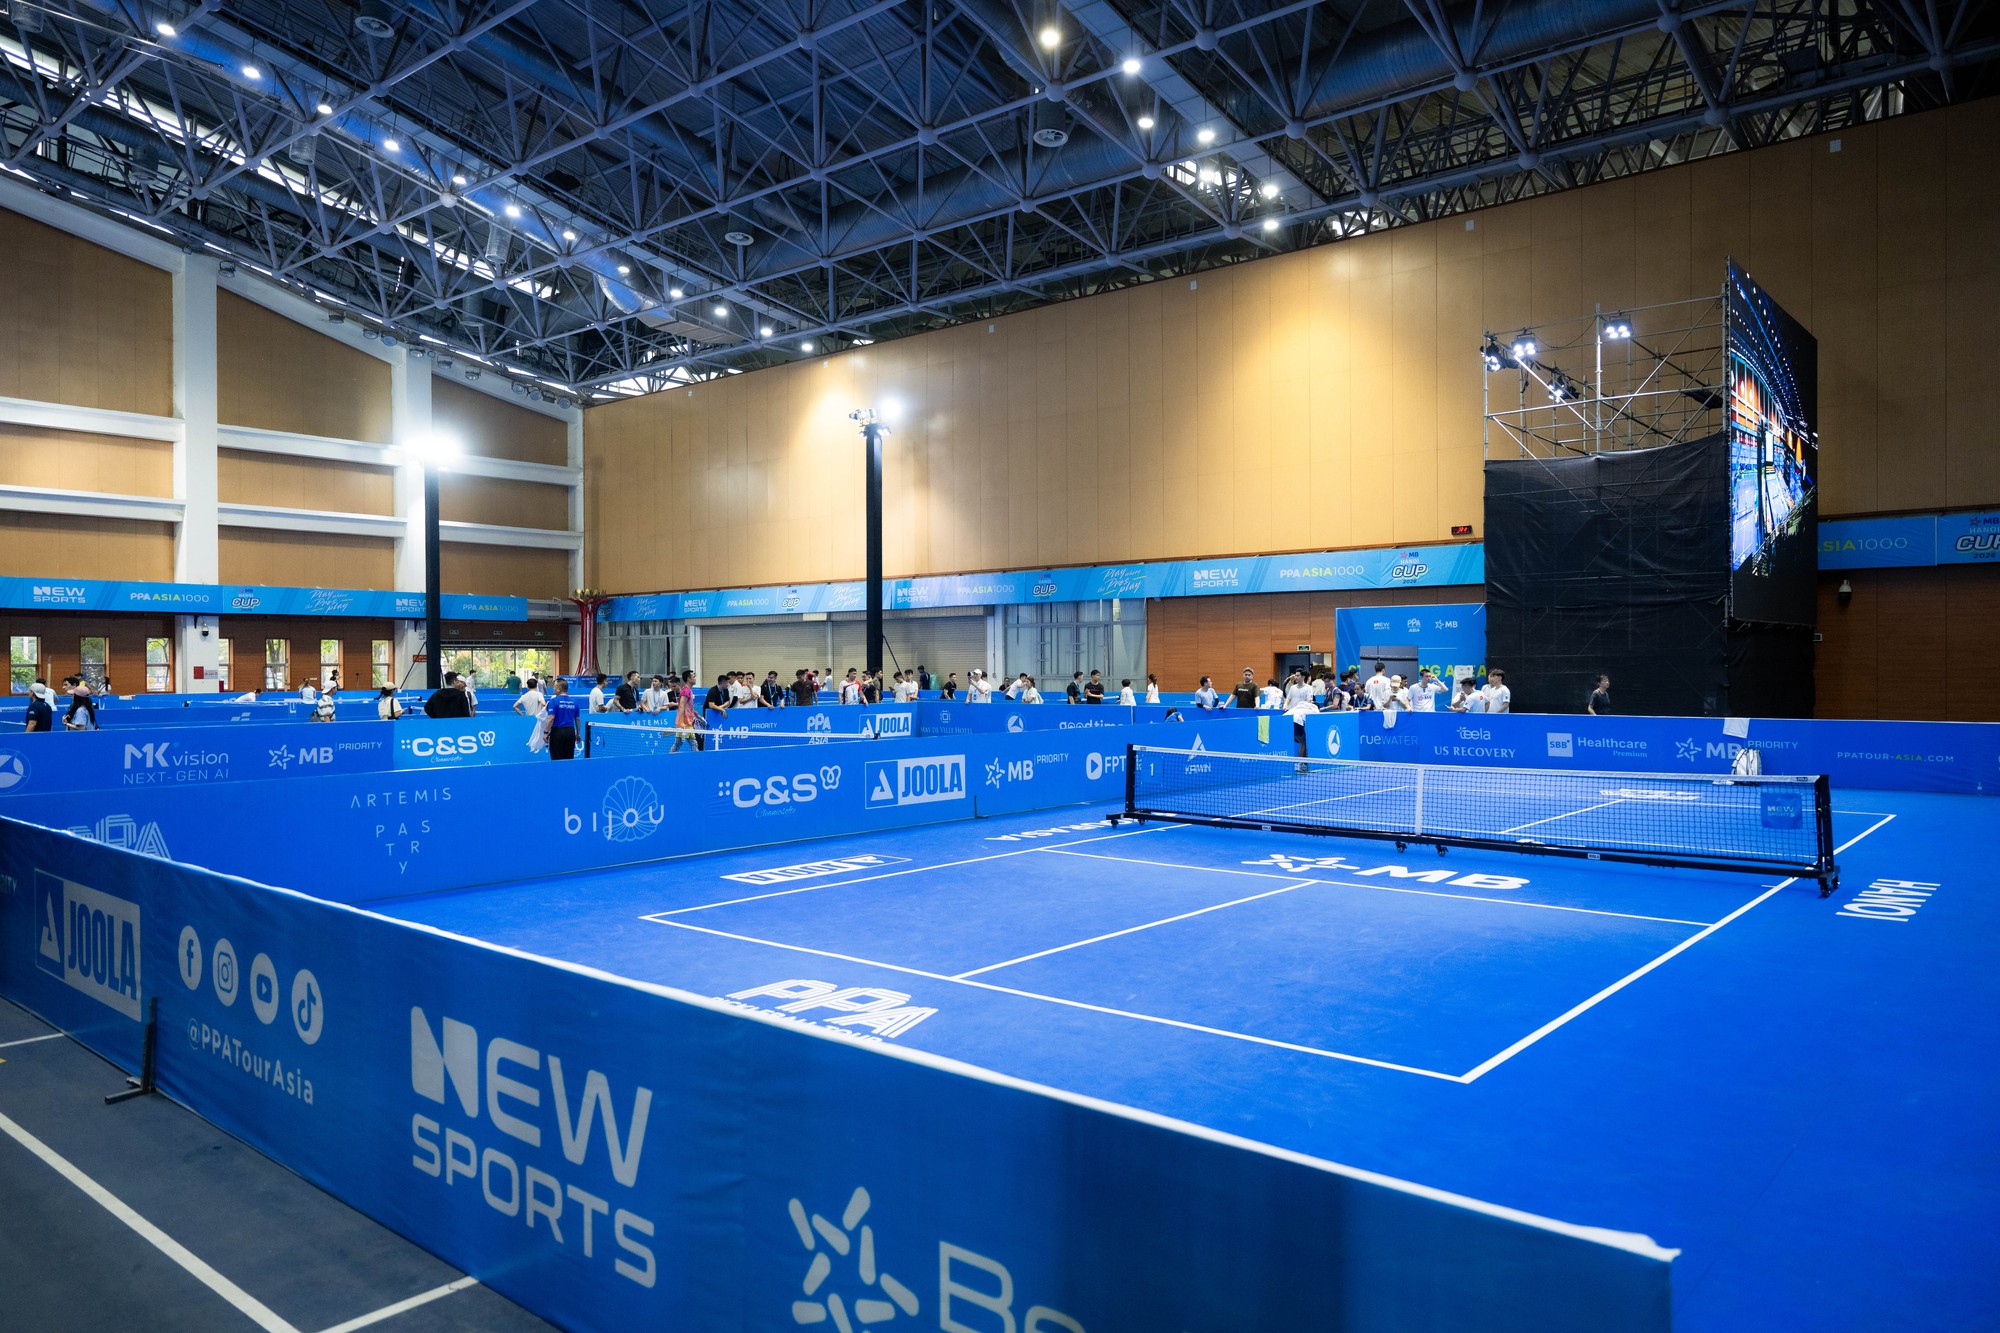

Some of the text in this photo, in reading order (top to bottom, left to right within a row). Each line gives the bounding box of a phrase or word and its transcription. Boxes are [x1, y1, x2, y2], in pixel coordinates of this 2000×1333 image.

[1193, 568, 1239, 580] NEW
[1392, 564, 1428, 578] CUP
[33, 586, 85, 597] NEW
[897, 586, 930, 597] NEW
[1032, 584, 1057, 596] CUP
[1193, 579, 1239, 588] SPORTS
[33, 595, 86, 604] SPORTS
[231, 597, 261, 608] CUP
[684, 599, 708, 607] NEW
[897, 595, 929, 604] SPORTS
[1407, 618, 1421, 627] PPA
[752, 722, 778, 730] PRIORITY
[807, 713, 831, 731] PPA
[877, 716, 910, 734] JOOLA
[412, 735, 478, 757] C&S
[1434, 746, 1516, 758] US RECOVERY
[1577, 737, 1648, 750] Healthcare
[1705, 740, 1799, 760] MB PRIORITY
[123, 742, 230, 770] MK vision
[299, 741, 383, 765] MB PRIORITY
[1612, 750, 1648, 758] Premium
[1007, 752, 1069, 782] MB PRIORITY
[1104, 755, 1126, 774] FPT
[214, 768, 229, 780] AI
[901, 763, 963, 798] JOOLA
[350, 787, 452, 809] ARTEMIS
[733, 773, 818, 808] C&S
[1351, 864, 1531, 890] MB
[1835, 878, 1942, 922] HANOI
[67, 899, 138, 1001] JOOLA
[725, 978, 940, 1039] PPA
[187, 1017, 314, 1105] @PPATourAsia
[409, 1004, 654, 1189] NEW
[410, 1111, 658, 1290] SPORTS
